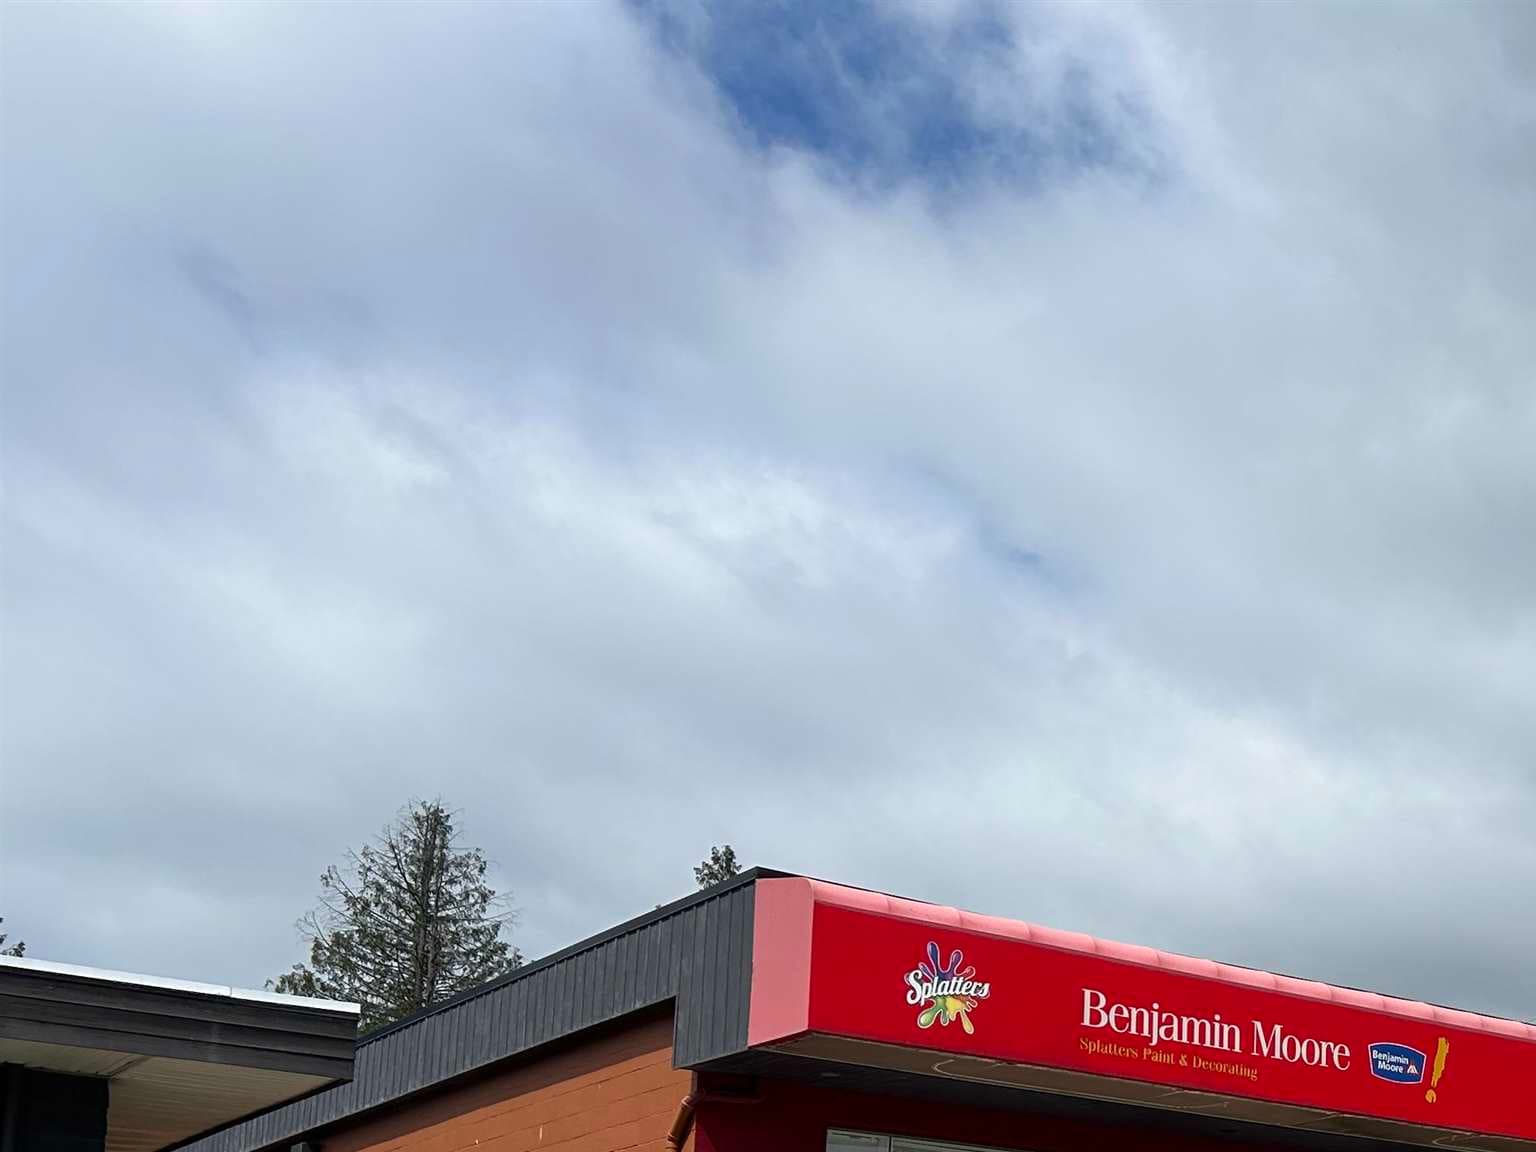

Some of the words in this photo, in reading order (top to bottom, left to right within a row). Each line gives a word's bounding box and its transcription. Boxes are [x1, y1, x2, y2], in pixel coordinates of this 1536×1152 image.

[907, 969, 990, 1006] Splatters
[1080, 988, 1243, 1053] Benjamin
[1251, 1020, 1350, 1071] Moore
[1079, 1037, 1139, 1059] Splatters
[1143, 1047, 1175, 1065] Paint
[1178, 1054, 1188, 1067] &
[1193, 1056, 1258, 1081] Decorating
[1372, 1049, 1409, 1066] Benjamin
[1378, 1060, 1404, 1074] Moore
